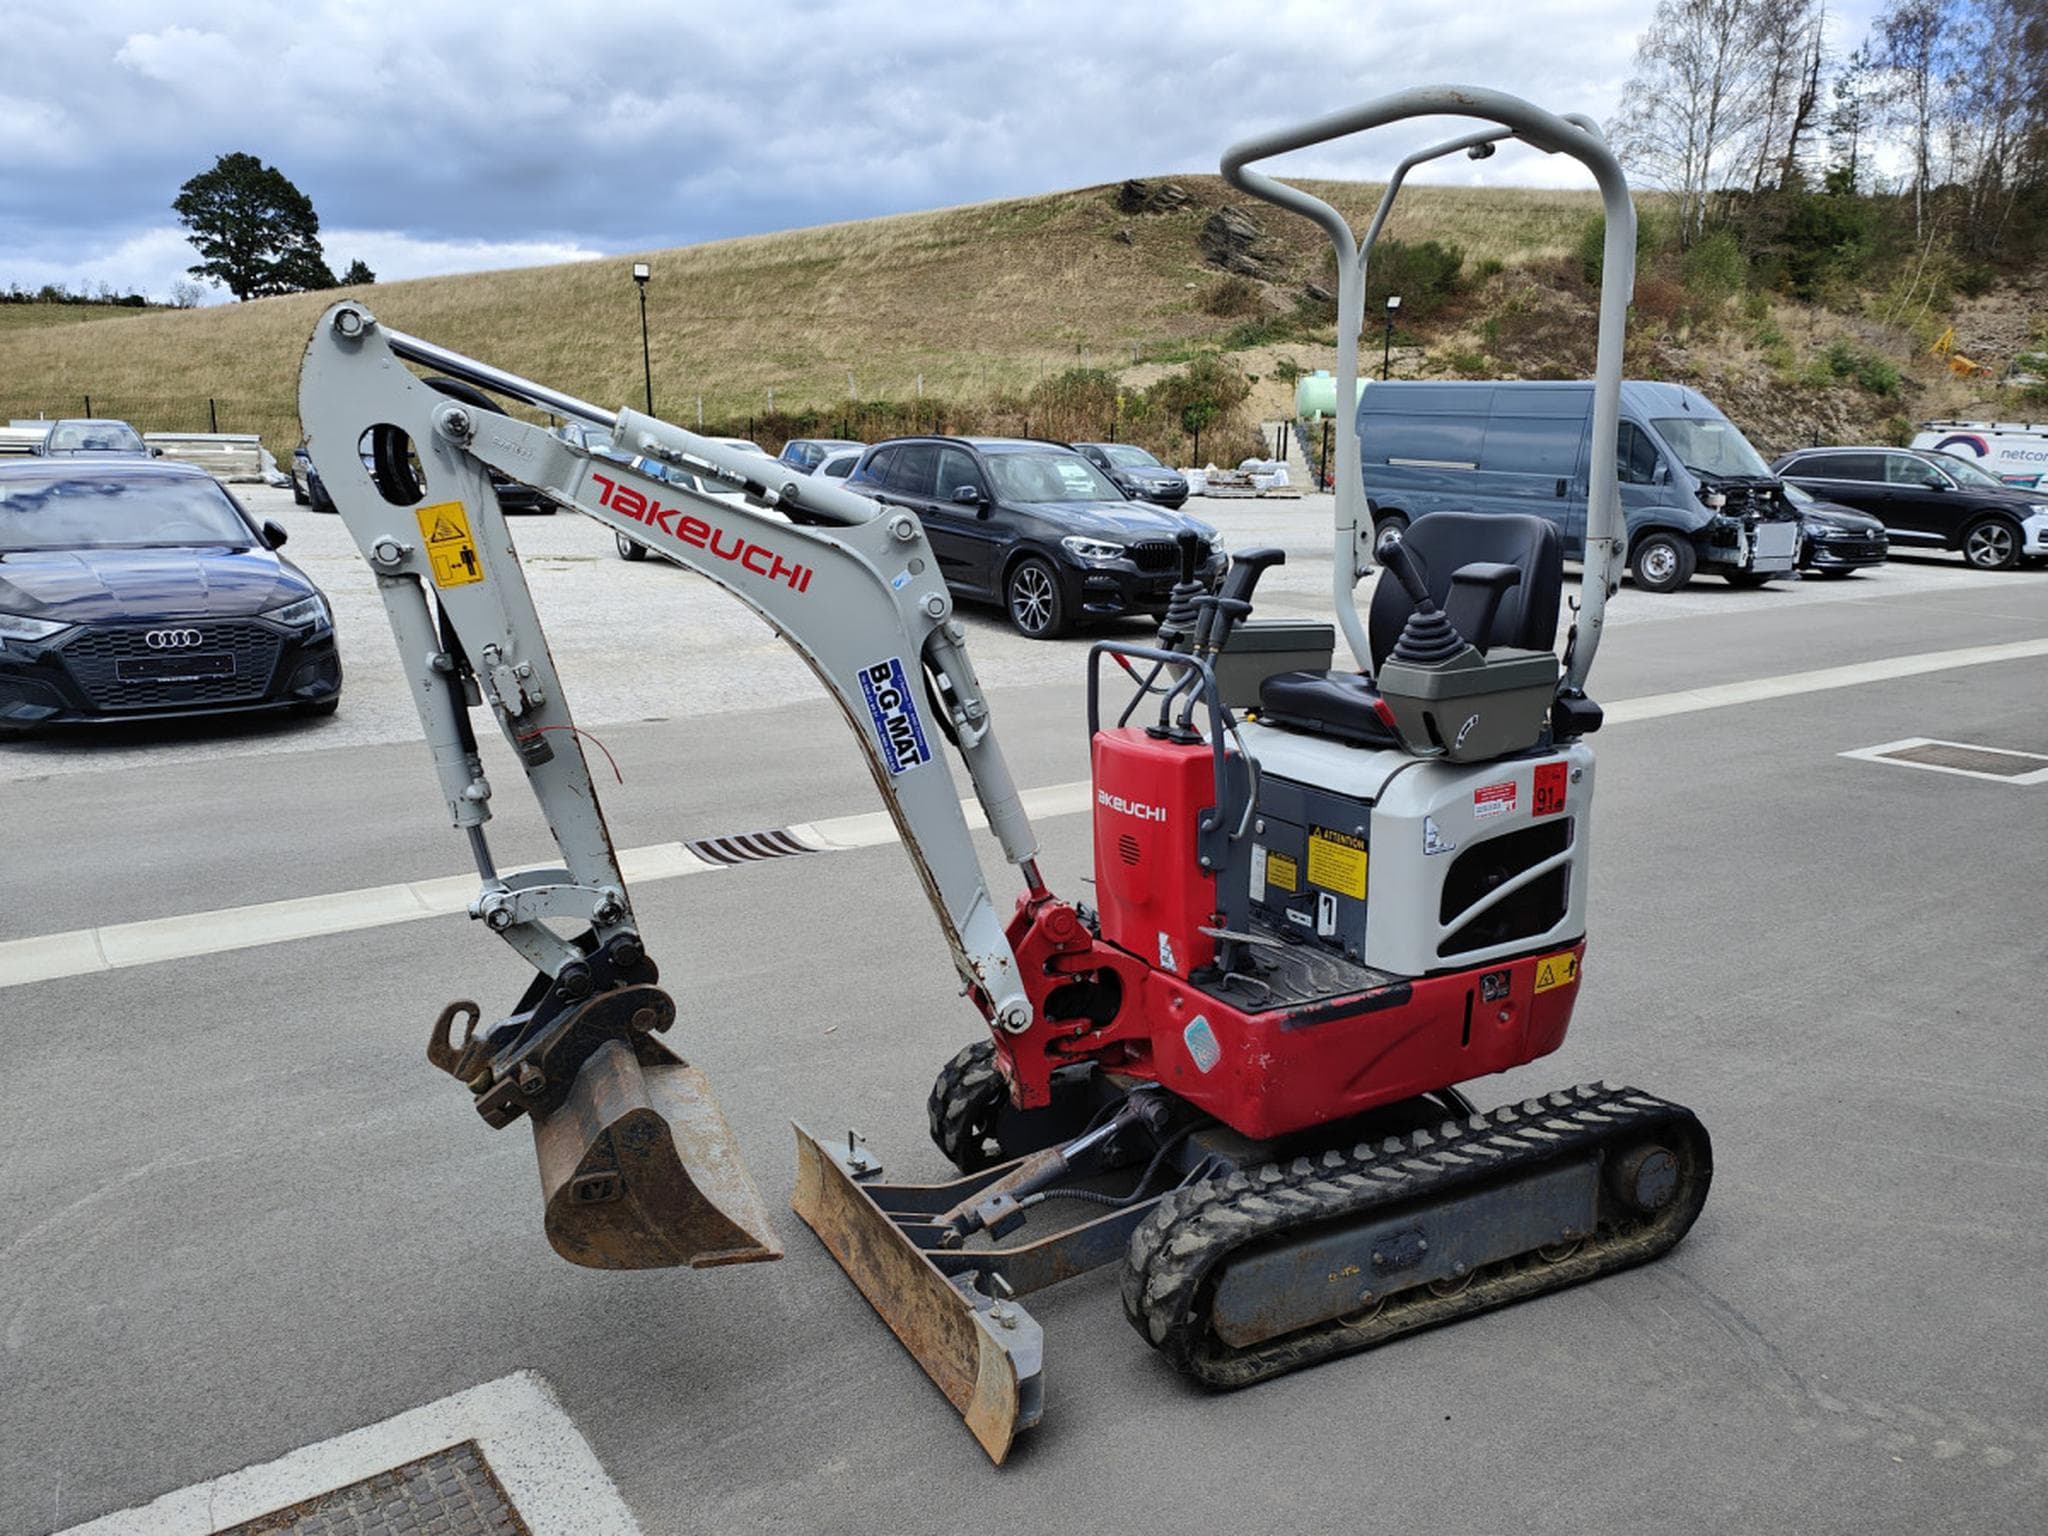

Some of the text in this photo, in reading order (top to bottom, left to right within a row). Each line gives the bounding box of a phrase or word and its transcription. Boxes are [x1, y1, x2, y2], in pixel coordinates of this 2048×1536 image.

[886, 715, 920, 765] MAT
[1536, 786, 1554, 812] 91
[1323, 829, 1365, 850] ATTENTION
